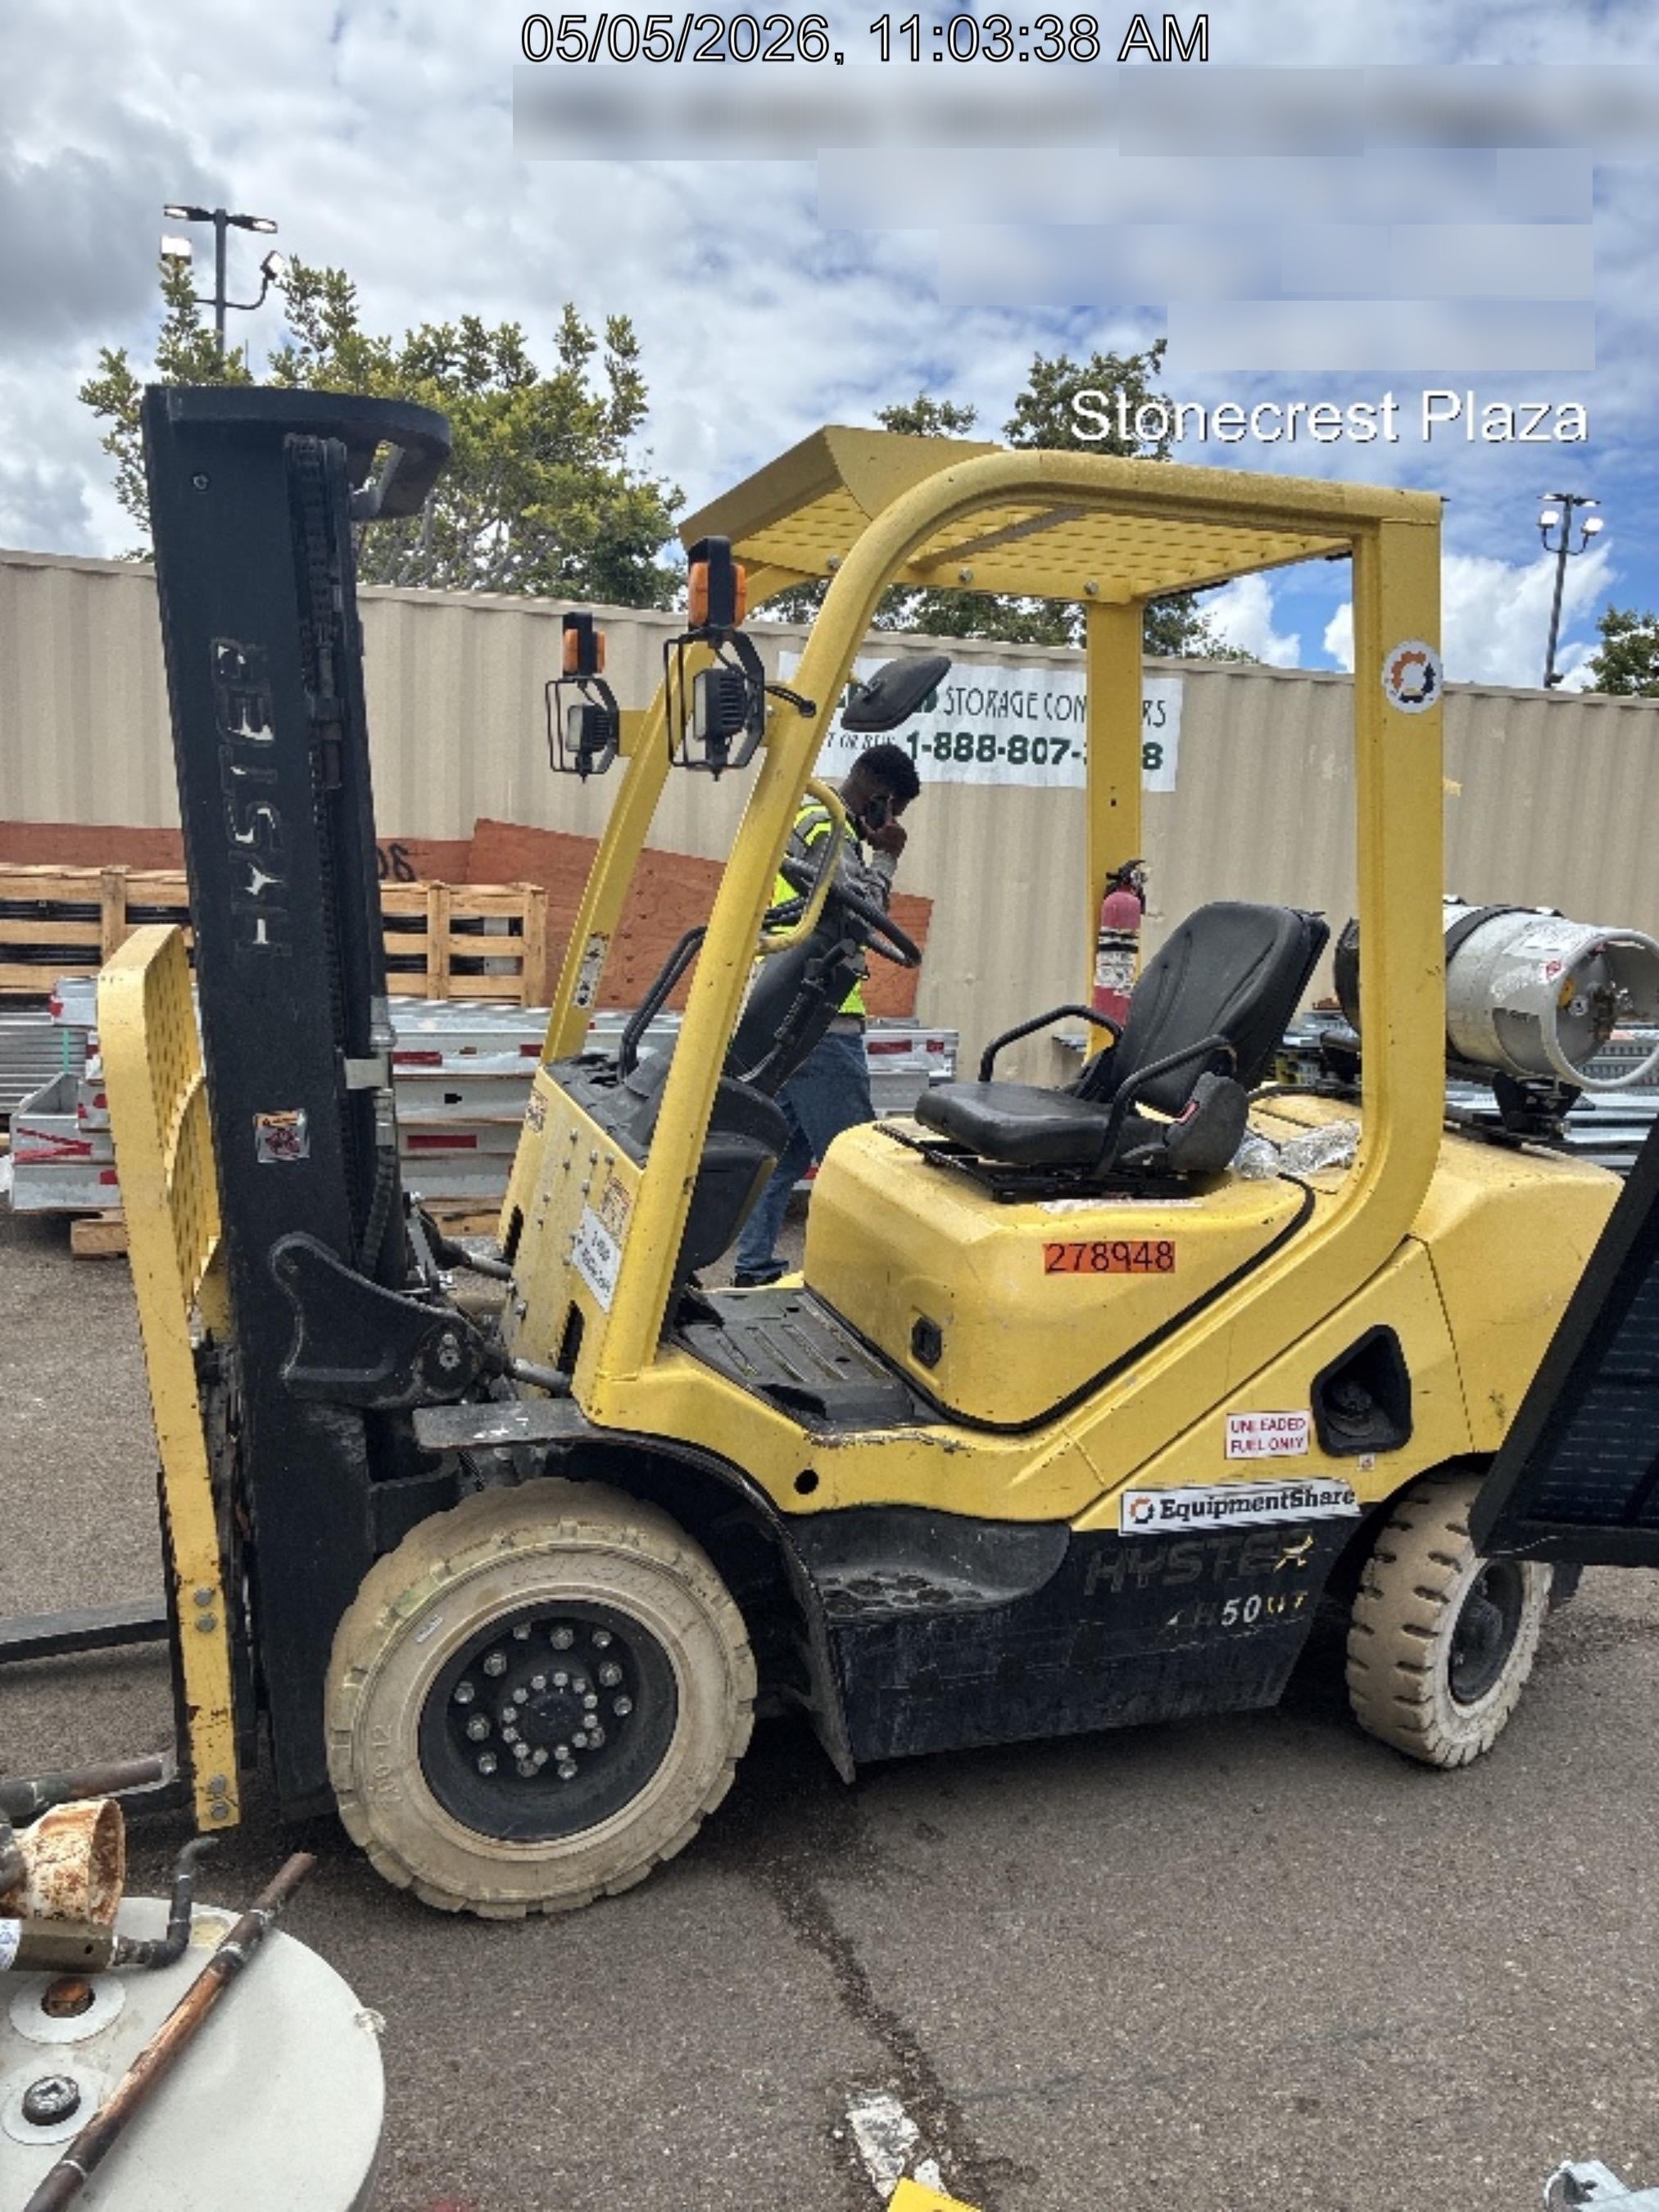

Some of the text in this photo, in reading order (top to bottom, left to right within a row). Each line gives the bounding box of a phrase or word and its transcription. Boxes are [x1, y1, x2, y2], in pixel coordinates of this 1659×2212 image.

[944, 687, 1038, 721] STORAGE
[1045, 695, 1166, 728] CONRS
[906, 729, 1163, 771] 1-888-807-8
[1046, 1240, 1174, 1273] 278948
[1231, 1417, 1306, 1434] UNEADED
[1160, 1484, 1357, 1521] EquipmentShare
